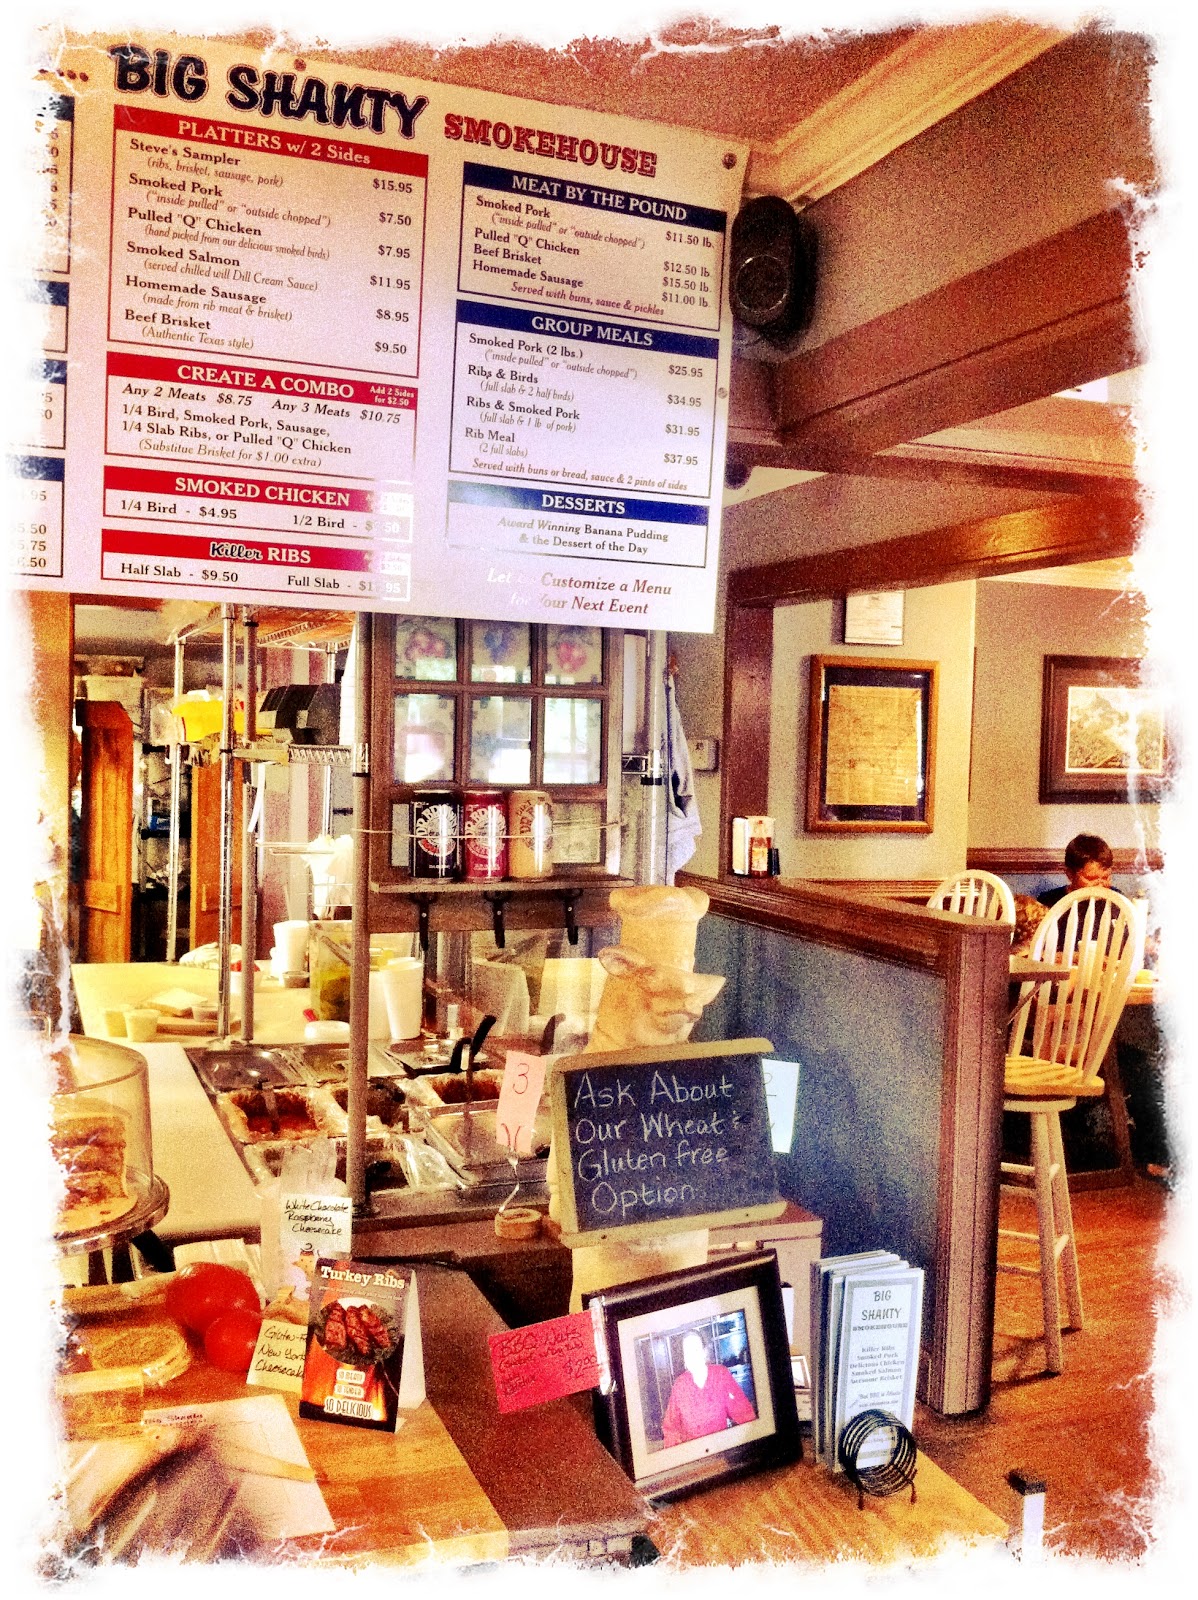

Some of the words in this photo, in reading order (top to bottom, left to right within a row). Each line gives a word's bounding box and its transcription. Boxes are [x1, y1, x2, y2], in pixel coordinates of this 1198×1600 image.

[107, 43, 209, 102] BIG
[225, 64, 429, 140] SHANTY
[130, 139, 177, 156] Steve's
[183, 147, 240, 166] Sampler
[178, 120, 281, 150] PLATTERS
[287, 141, 306, 154] w/
[311, 143, 321, 157] 2
[327, 145, 370, 164] Sides
[444, 113, 657, 178] SMOKEHOUSE
[129, 173, 186, 191] Smoked
[191, 182, 222, 196] Pork
[373, 178, 412, 193] $15.95
[476, 195, 522, 213] Smoked
[525, 204, 550, 218] Pork
[512, 176, 561, 196] MEAT
[566, 186, 589, 201] BY
[591, 190, 625, 209] THE
[629, 198, 686, 220] POUND
[128, 207, 172, 224] Pulled
[177, 214, 201, 228] "Q"
[206, 218, 261, 236] Chicken
[379, 212, 411, 226] $7.50
[475, 228, 510, 243] Pulled
[514, 234, 532, 248] "Q"
[536, 238, 580, 255] Chicken
[666, 231, 698, 245] $11.50
[127, 241, 183, 258] Smoked
[189, 250, 240, 266] Salmon
[378, 245, 410, 258] $7.95
[474, 244, 502, 257] Beef
[502, 248, 541, 264] Brisket
[473, 260, 536, 279] Homemade
[540, 271, 584, 288] Sausage
[664, 261, 696, 275] $12.50
[126, 275, 206, 295] Homemade
[211, 287, 266, 304] Sausage
[370, 275, 410, 290] $11.95
[662, 277, 696, 290] $15.50
[511, 282, 544, 296] Served
[546, 289, 566, 300] with
[569, 292, 593, 305] buns,
[596, 298, 621, 308] sauce
[624, 300, 632, 310] &
[634, 304, 664, 315] pickles
[662, 292, 695, 305] $11.00
[125, 309, 157, 321] Beef
[162, 313, 211, 329] Brisket
[376, 309, 409, 322] $8.95
[532, 316, 593, 336] GROUP
[597, 326, 652, 346] MEALS
[375, 342, 407, 354] $9.50
[469, 332, 514, 349] Smoked
[518, 340, 542, 353] Pork
[547, 345, 557, 355] (2
[561, 346, 583, 358] lbs.)
[178, 365, 256, 387] CREATE
[261, 376, 276, 389] A
[281, 377, 354, 398] COMBO
[468, 364, 492, 378] Ribs
[496, 369, 505, 379] &
[510, 370, 538, 384] Birds
[668, 365, 702, 378] $25.95
[122, 383, 149, 397] Any
[154, 387, 162, 397] 2
[168, 388, 206, 401] Meats
[217, 393, 252, 406] $8.75
[370, 386, 385, 394] Add
[394, 389, 414, 398] Sides
[667, 394, 701, 407] $34.95
[272, 399, 297, 413] Any
[301, 403, 309, 412] 3
[315, 403, 350, 417] Meats
[360, 410, 401, 424] $10.75
[466, 396, 491, 408] Ribs
[494, 400, 504, 411] &
[508, 402, 552, 416] Smoked
[556, 408, 580, 419] Pork
[123, 404, 142, 415] 1/4
[148, 406, 179, 421] Bird,
[184, 410, 235, 425] Smoked
[240, 416, 272, 430] Pork,
[277, 420, 330, 437] Sausage,
[665, 424, 700, 436] $31.95
[123, 421, 141, 432] 1/4
[147, 423, 174, 435] Slab
[180, 426, 211, 441] Ribs,
[216, 432, 229, 441] or
[234, 432, 272, 446] Pulled
[278, 436, 298, 448] "Q"
[303, 439, 351, 454] Chicken
[465, 427, 484, 439] Rib
[488, 430, 515, 442] Meal
[664, 453, 698, 465] $37.95
[176, 478, 259, 498] SMOKED
[265, 486, 350, 506] CHICKEN
[122, 500, 141, 511] 1/4
[148, 502, 177, 514] Bird
[200, 506, 237, 519] $4.95
[542, 494, 626, 514] DESSERTS
[294, 515, 312, 525] 1/2
[317, 517, 345, 528] Bird
[498, 517, 534, 529] Award
[538, 520, 580, 535] Winning
[585, 525, 622, 537] Banana
[627, 528, 668, 542] Pudding
[210, 542, 263, 560] Killer
[268, 548, 311, 563] RIBS
[519, 533, 528, 543] &
[533, 535, 549, 545] the
[553, 537, 592, 549] Dessert
[596, 541, 605, 550] of
[608, 542, 624, 551] the
[628, 543, 648, 555] Day
[122, 563, 149, 575] Half
[154, 566, 181, 578] Slab
[202, 570, 238, 582] $9.50
[288, 575, 309, 587] Full
[314, 577, 340, 589] Slab
[541, 572, 615, 591] Customize
[619, 584, 627, 592] a
[632, 580, 672, 595] Menu
[571, 596, 604, 612] Next
[608, 599, 648, 614] Event
[513, 1063, 529, 1094] 3
[574, 1072, 636, 1108] Ask
[650, 1070, 734, 1104] About
[575, 1119, 628, 1144] Our
[641, 1111, 723, 1142] Wheat
[578, 1148, 667, 1181] Gluten
[591, 1181, 693, 1219] Option
[321, 1266, 371, 1287] Turkey
[375, 1272, 405, 1289] Ribs
[873, 1290, 891, 1302] BIG
[862, 1308, 902, 1320] SHANTY
[336, 1399, 373, 1419] DELICIOUS
